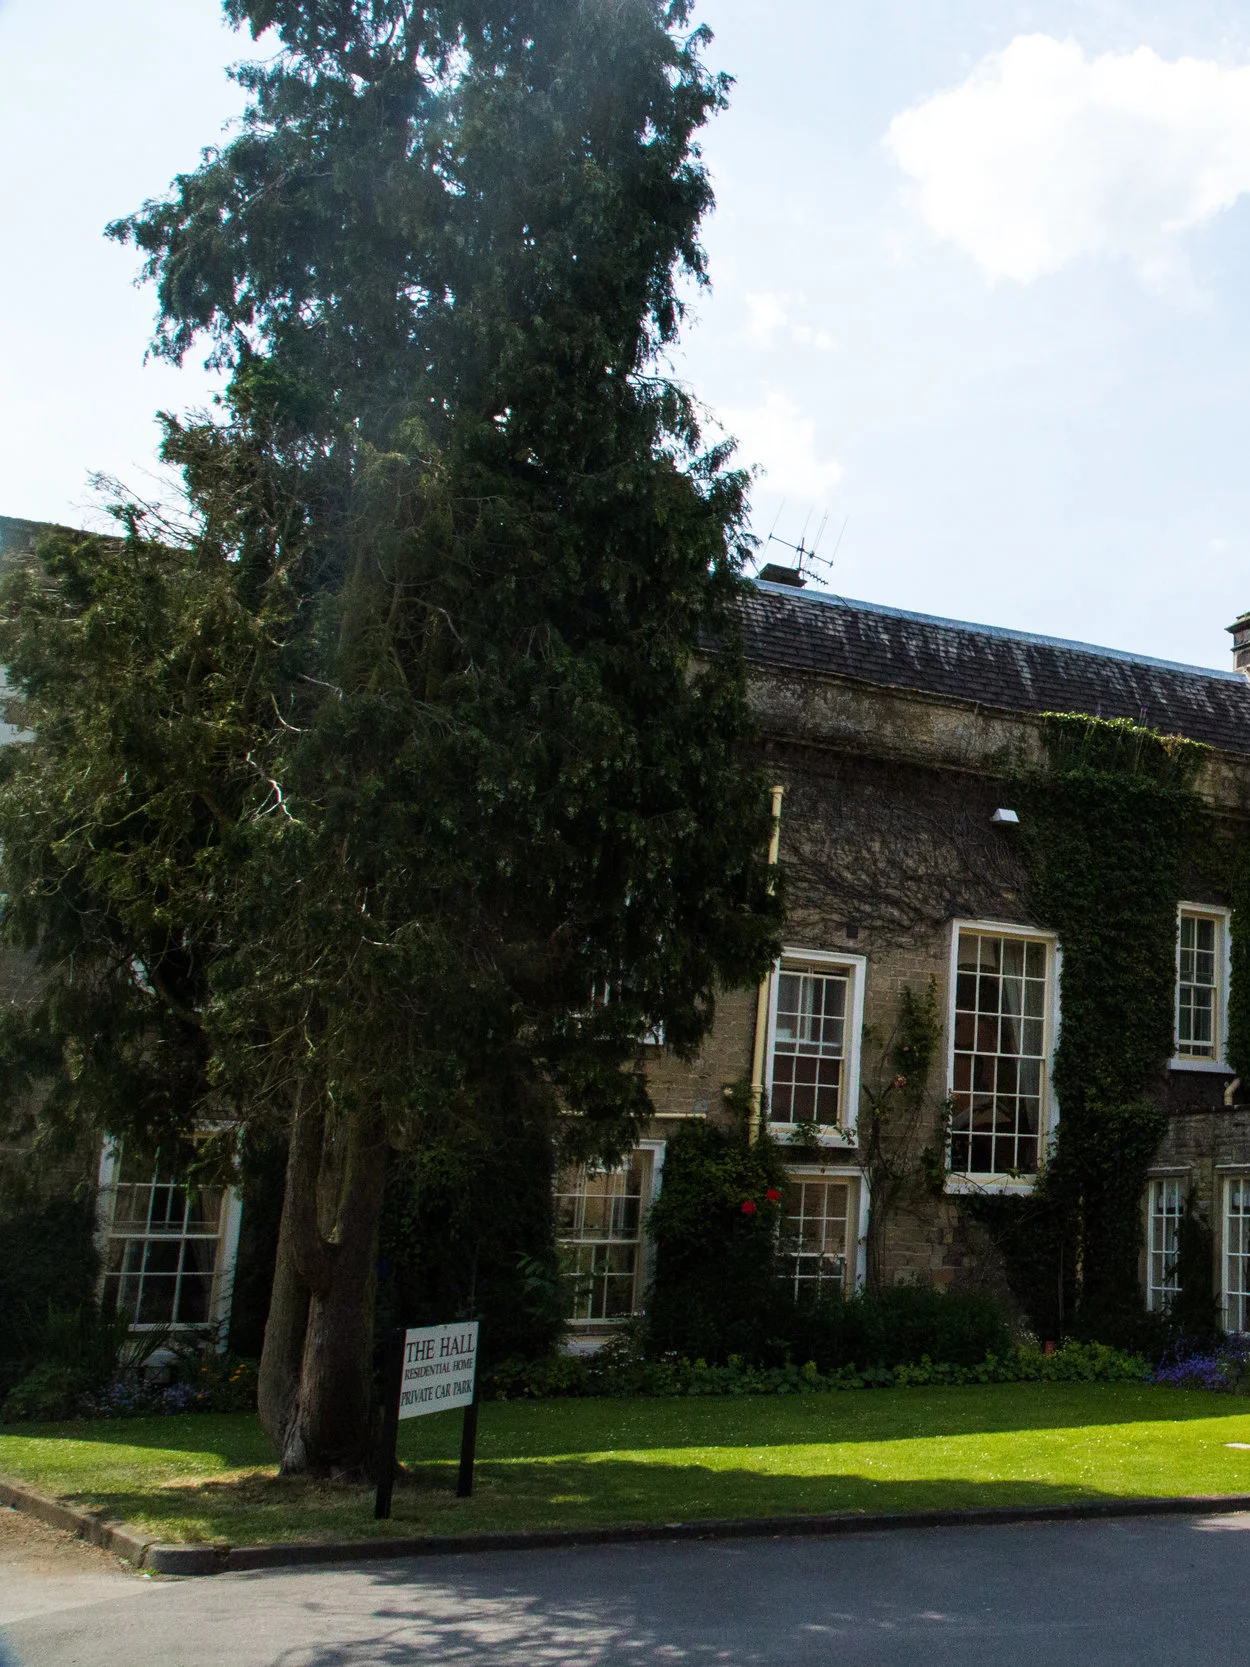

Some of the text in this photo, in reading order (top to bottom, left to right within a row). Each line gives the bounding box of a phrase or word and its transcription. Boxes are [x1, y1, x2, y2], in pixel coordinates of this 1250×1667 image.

[406, 1333, 475, 1363] THE HALL
[404, 1358, 473, 1380] RESIDENTIAL HOME
[401, 1379, 472, 1406] PRIVATE CAR PARK
